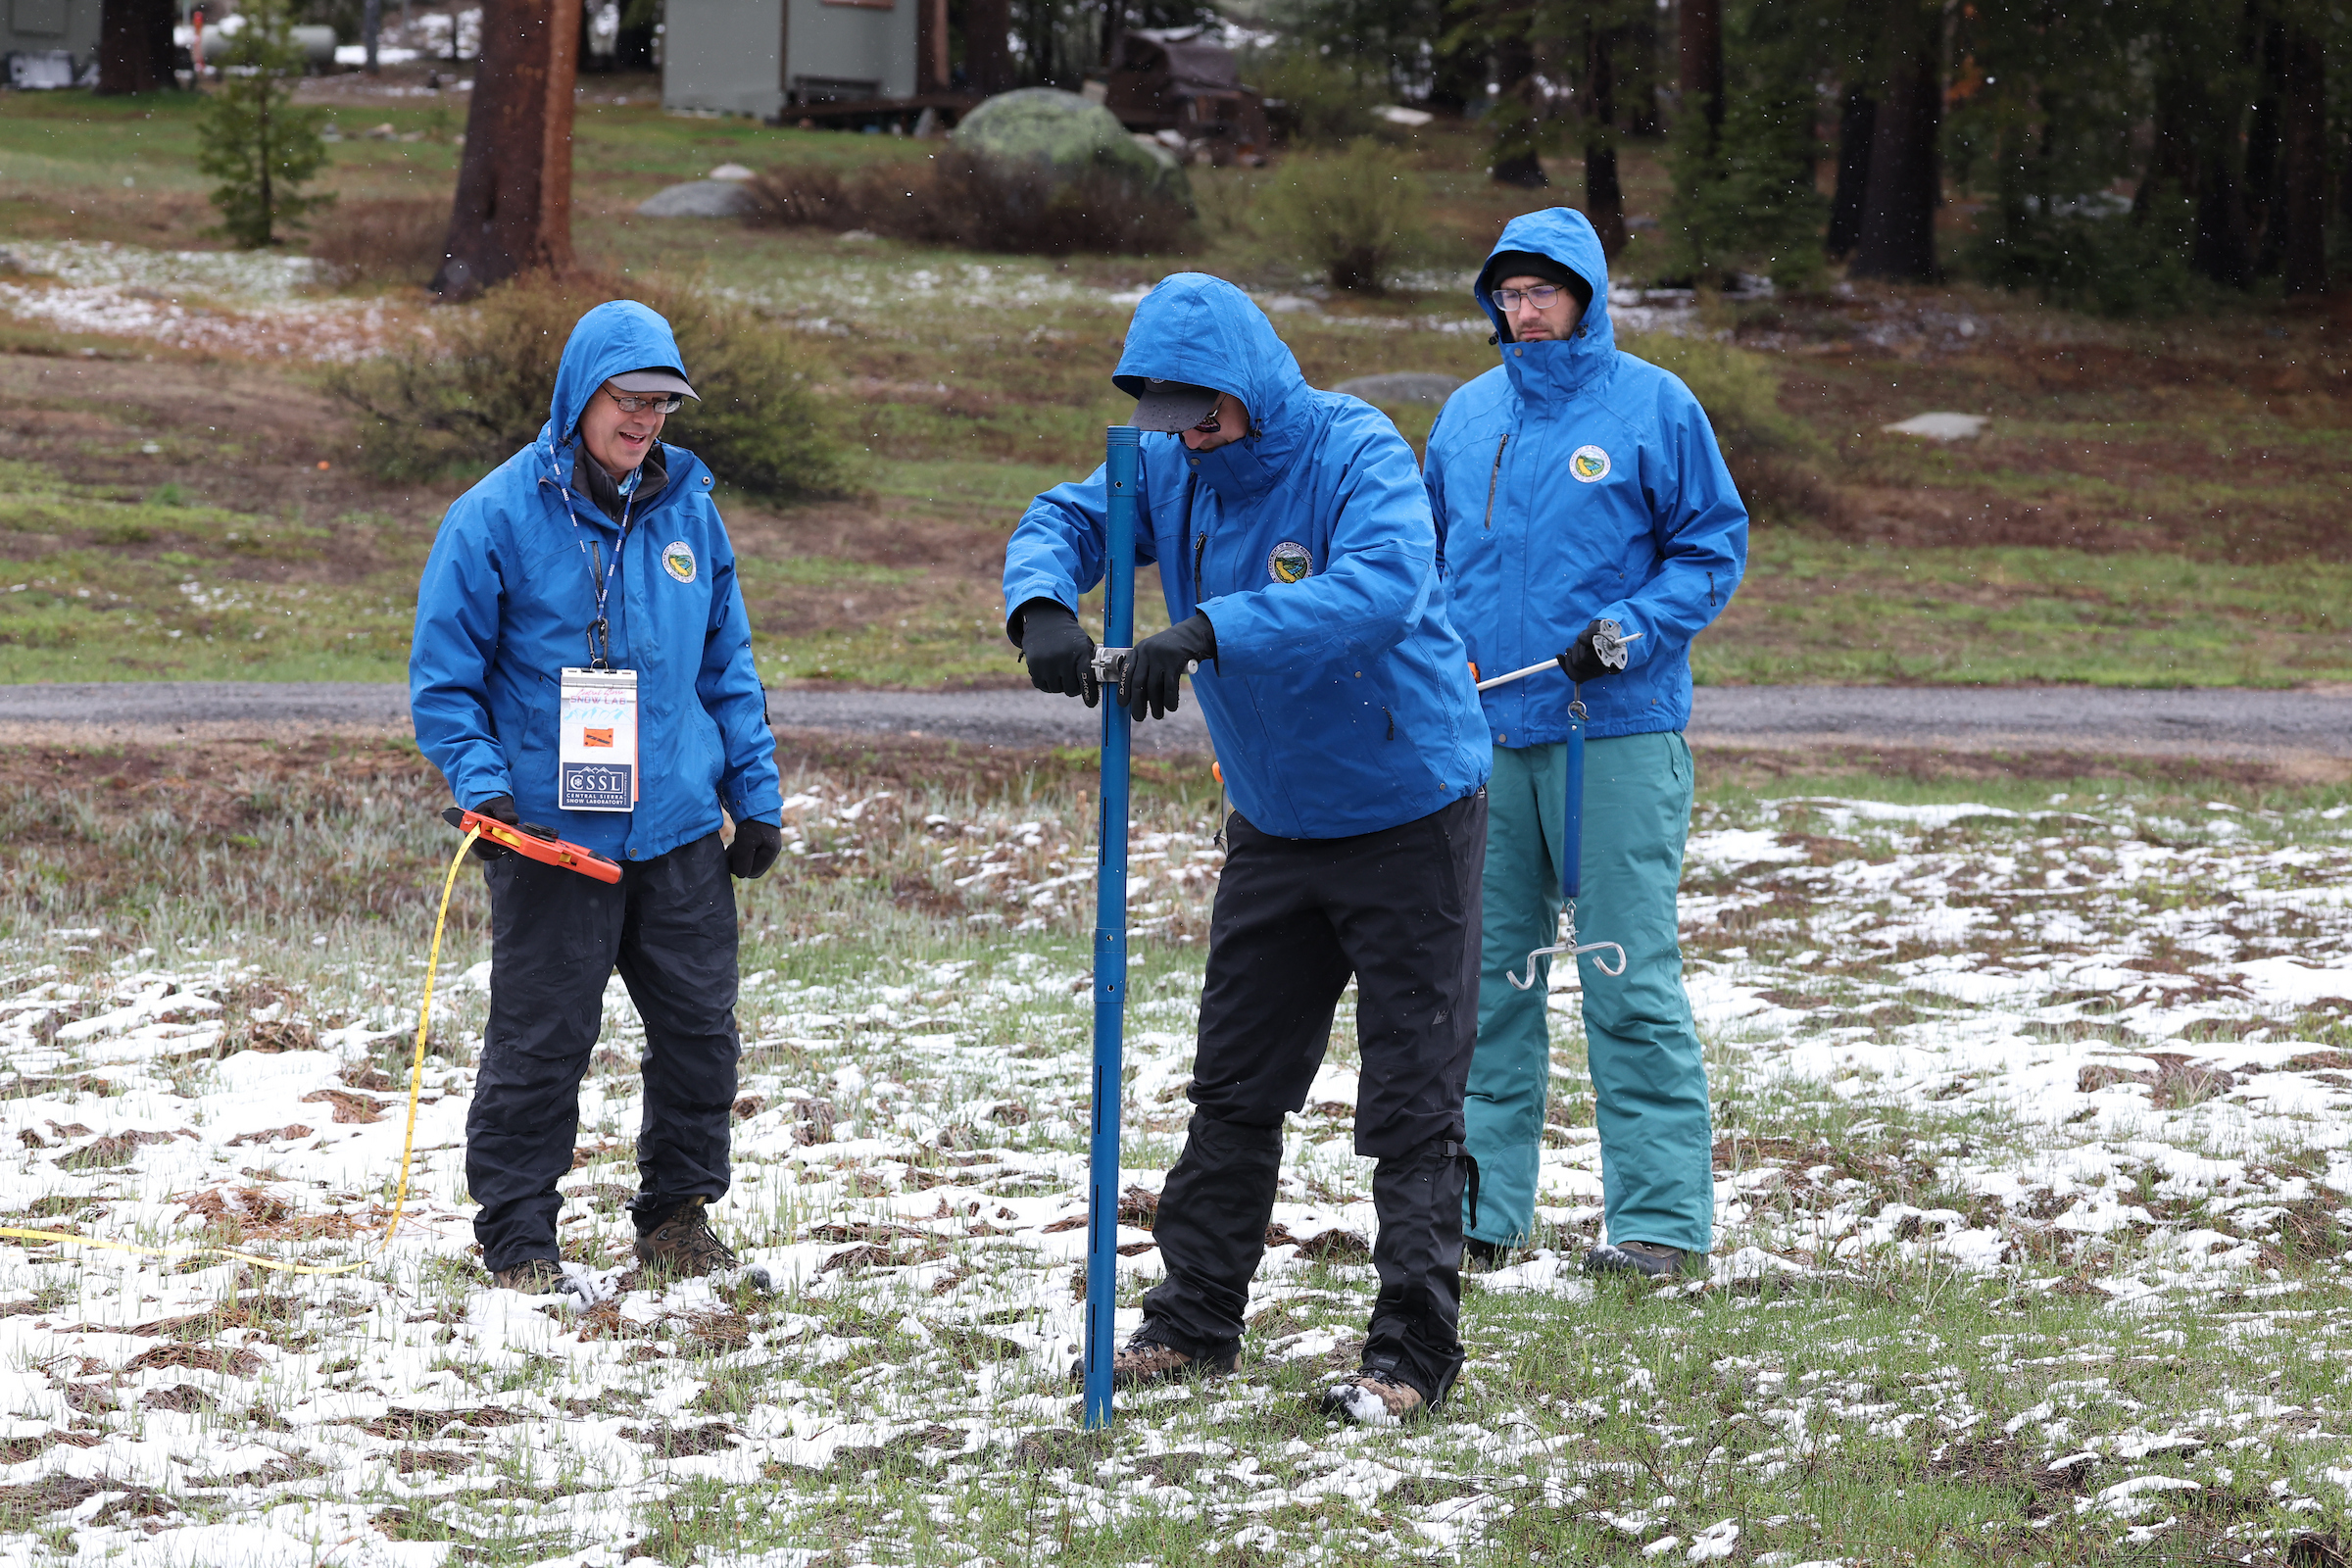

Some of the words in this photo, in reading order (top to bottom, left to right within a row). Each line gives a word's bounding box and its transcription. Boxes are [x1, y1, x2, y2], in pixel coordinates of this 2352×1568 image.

[1119, 662, 1130, 696] DAKINE
[577, 688, 602, 697] Central
[570, 695, 601, 704] SNOW
[569, 774, 621, 791] CSSL
